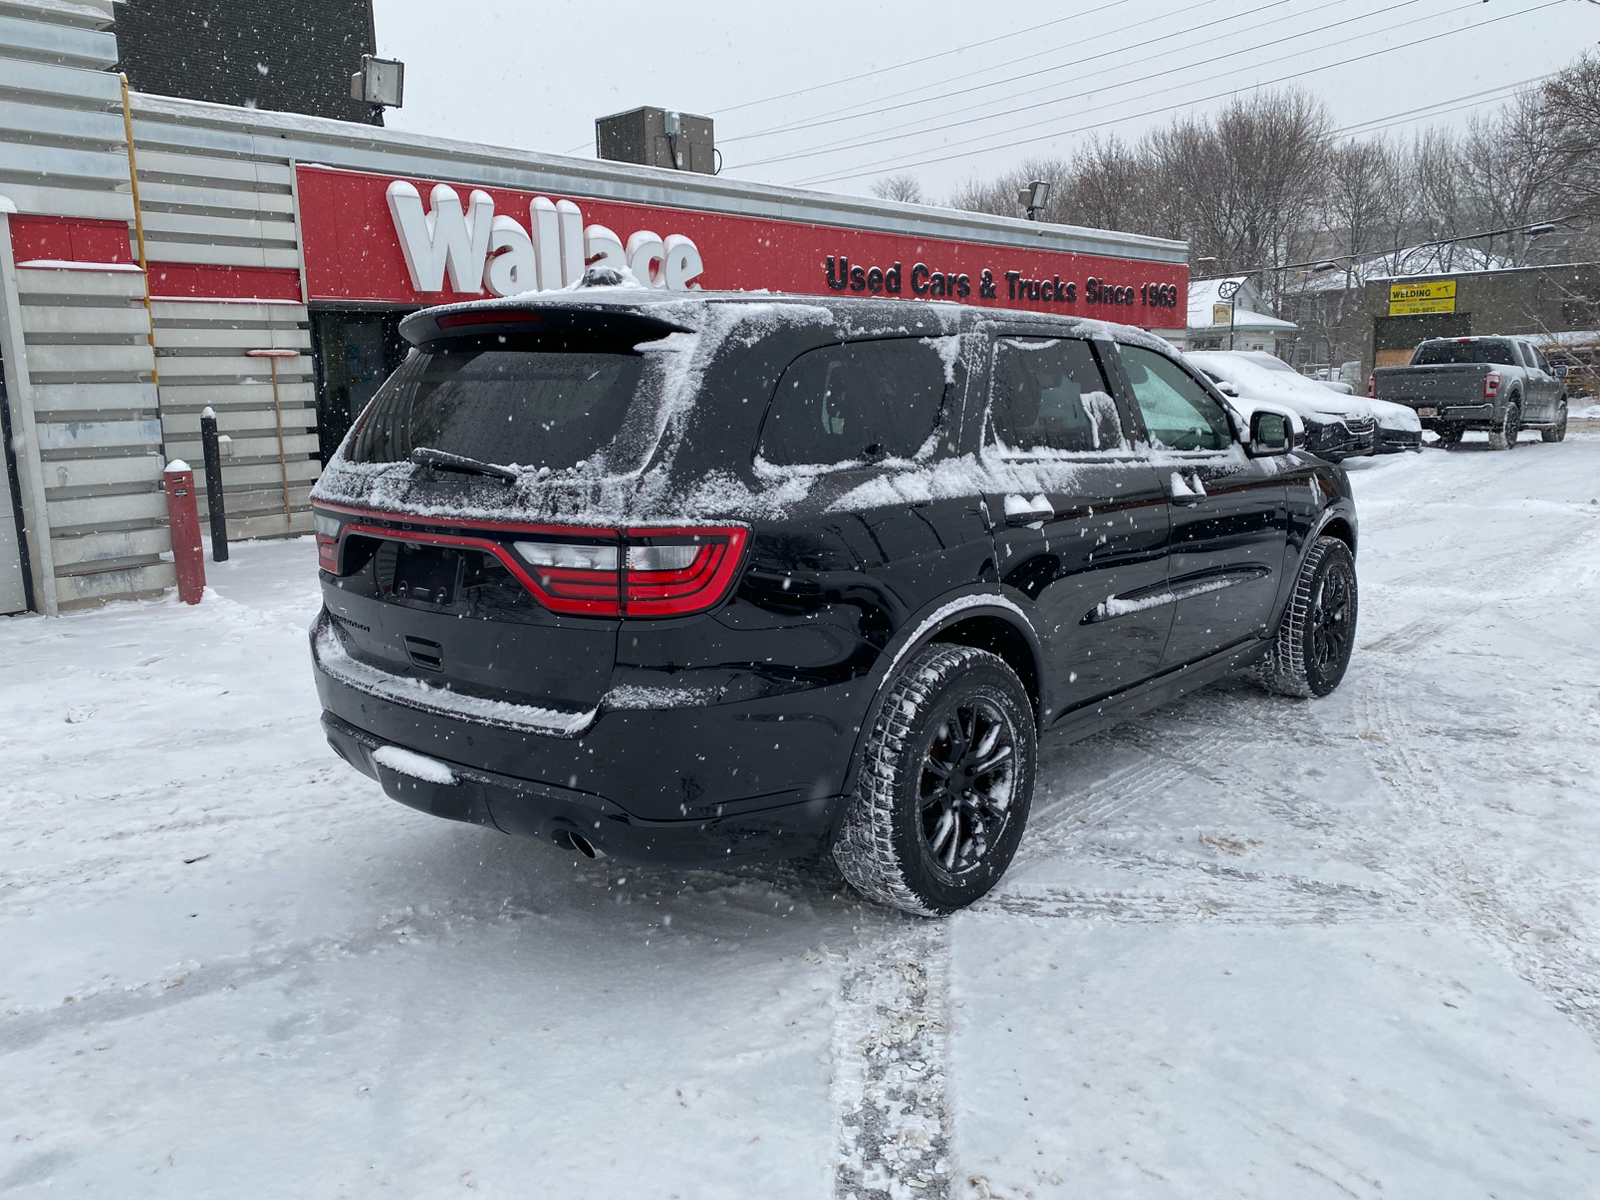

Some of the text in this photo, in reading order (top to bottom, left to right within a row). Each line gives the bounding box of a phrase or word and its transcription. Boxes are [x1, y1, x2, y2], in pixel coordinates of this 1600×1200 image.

[385, 180, 704, 296] Wallace
[826, 255, 1178, 308] Used Cars & Trucks Since 1963
[1392, 289, 1431, 299] WELDING
